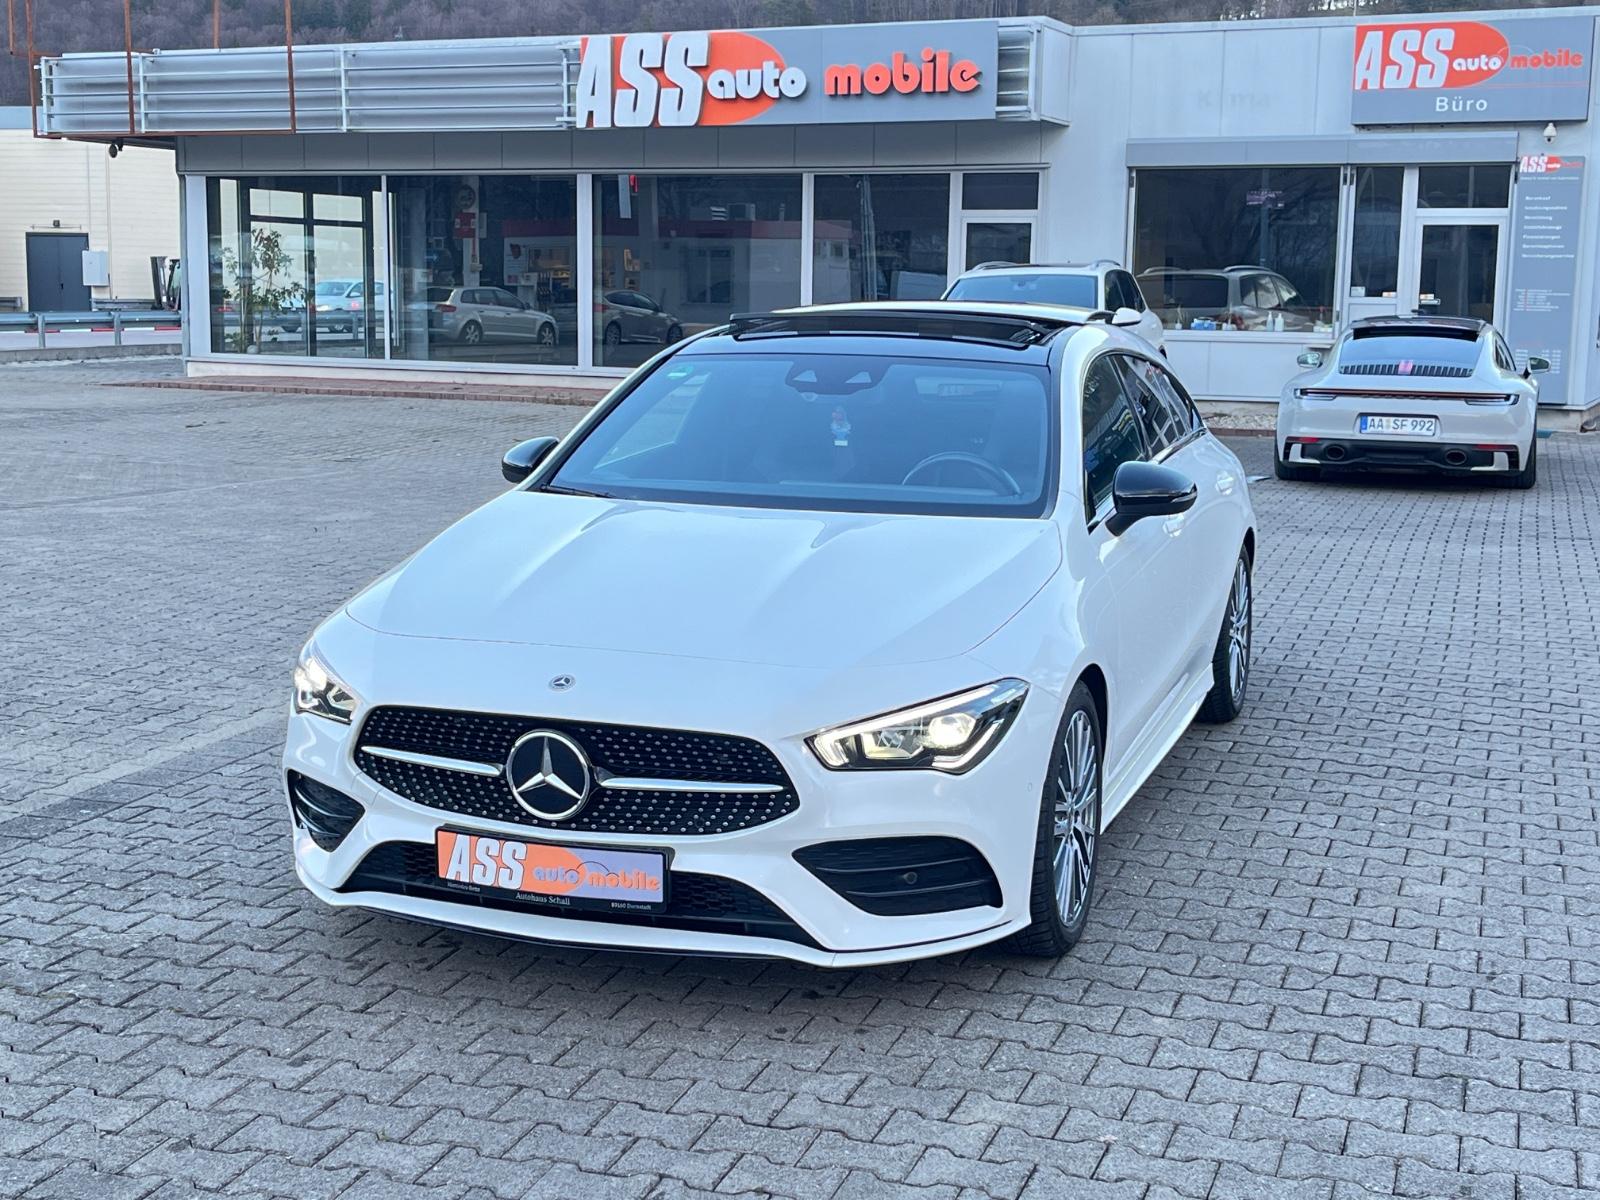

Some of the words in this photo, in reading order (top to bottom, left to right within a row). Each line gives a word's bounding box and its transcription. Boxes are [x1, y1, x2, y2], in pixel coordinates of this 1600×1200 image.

[1354, 28, 1456, 90] ASS
[1452, 54, 1502, 71] auto
[1509, 48, 1583, 69] mobile
[576, 32, 710, 128] ASS
[706, 60, 808, 100] auto
[823, 47, 983, 96] mobile
[1435, 95, 1488, 112] Büro
[1519, 155, 1548, 173] ASS
[1368, 418, 1384, 430] AA
[1392, 418, 1408, 430] SF
[1411, 419, 1434, 431] 992
[445, 833, 527, 890] ASS
[533, 865, 580, 885] auto
[588, 868, 661, 892] mobile
[515, 892, 548, 903] Autohaus
